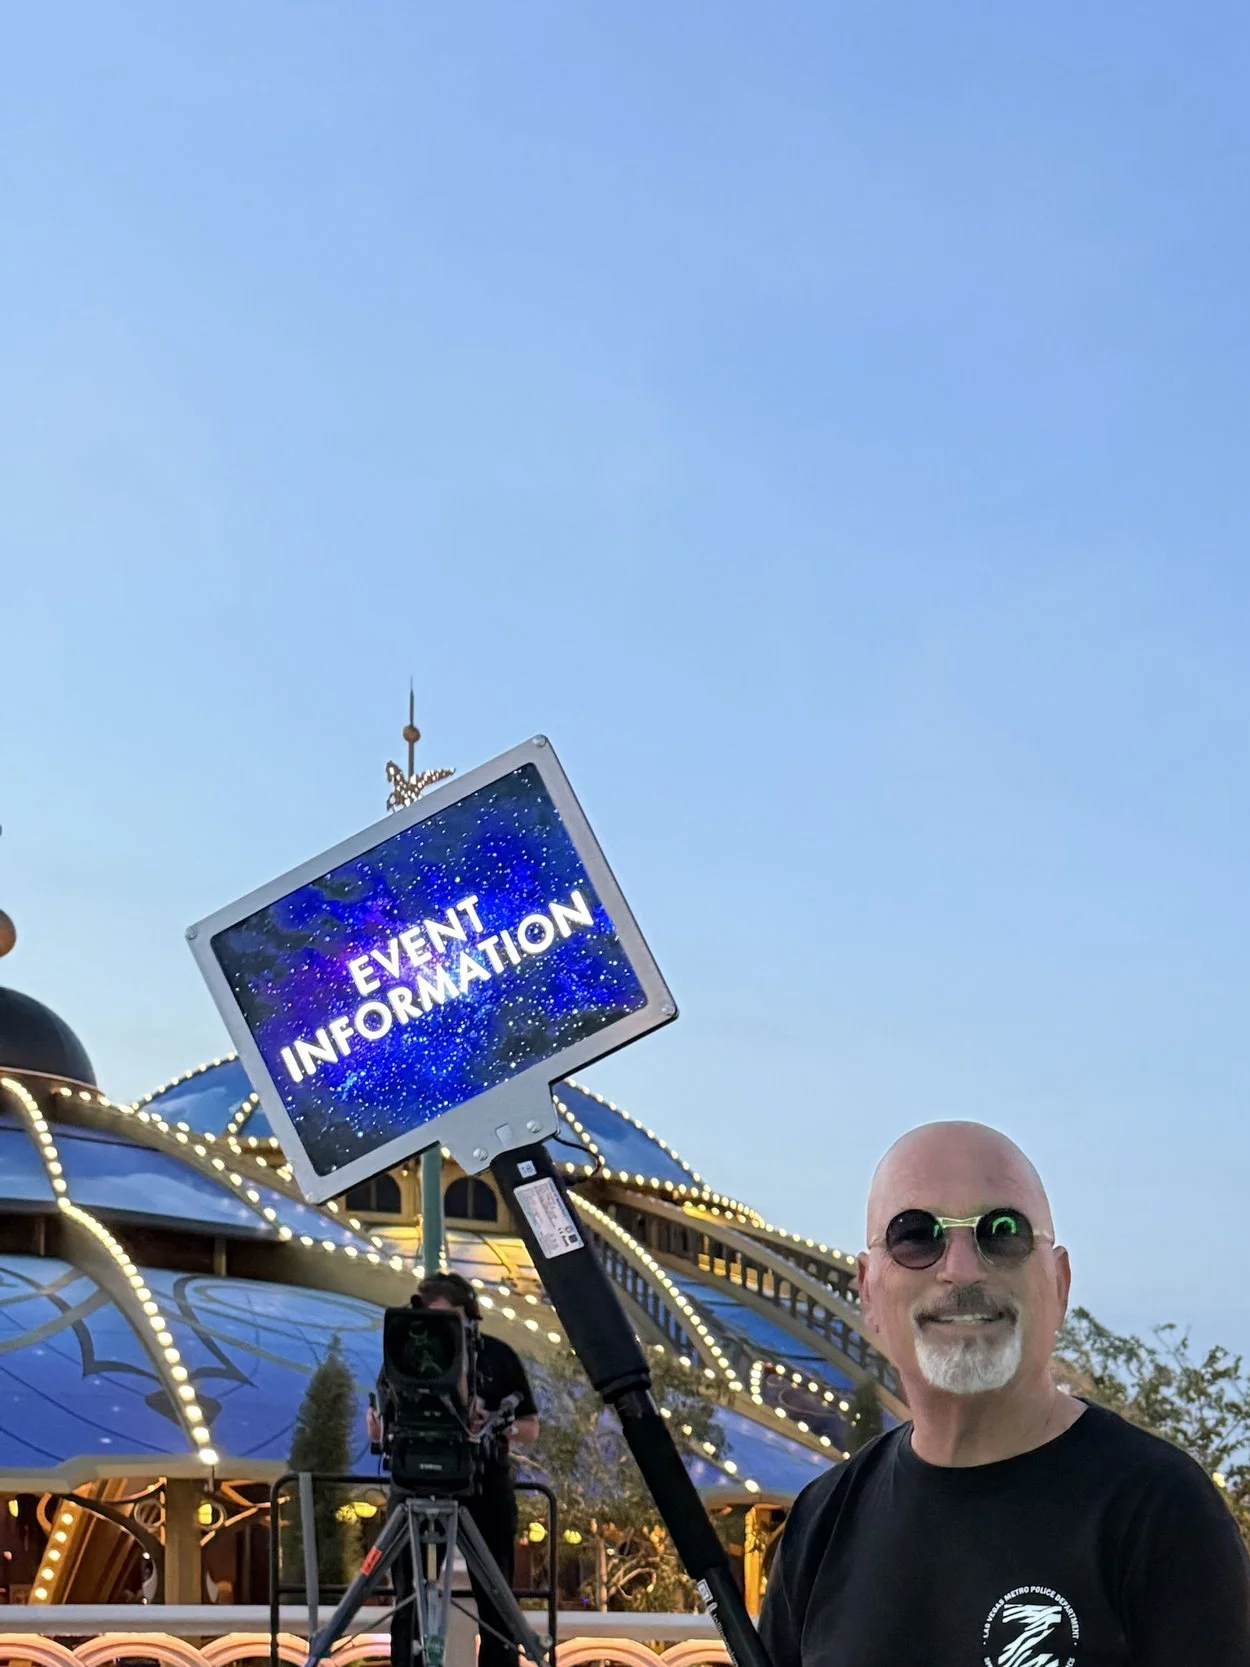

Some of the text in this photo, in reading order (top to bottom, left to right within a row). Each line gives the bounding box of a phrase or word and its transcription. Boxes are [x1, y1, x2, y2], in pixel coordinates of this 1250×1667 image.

[280, 890, 594, 1083] INFORMATION
[349, 894, 485, 997] EVENT
[983, 1585, 1080, 1640] LAS VEGAS METRO POLICE DEPARTMENT
